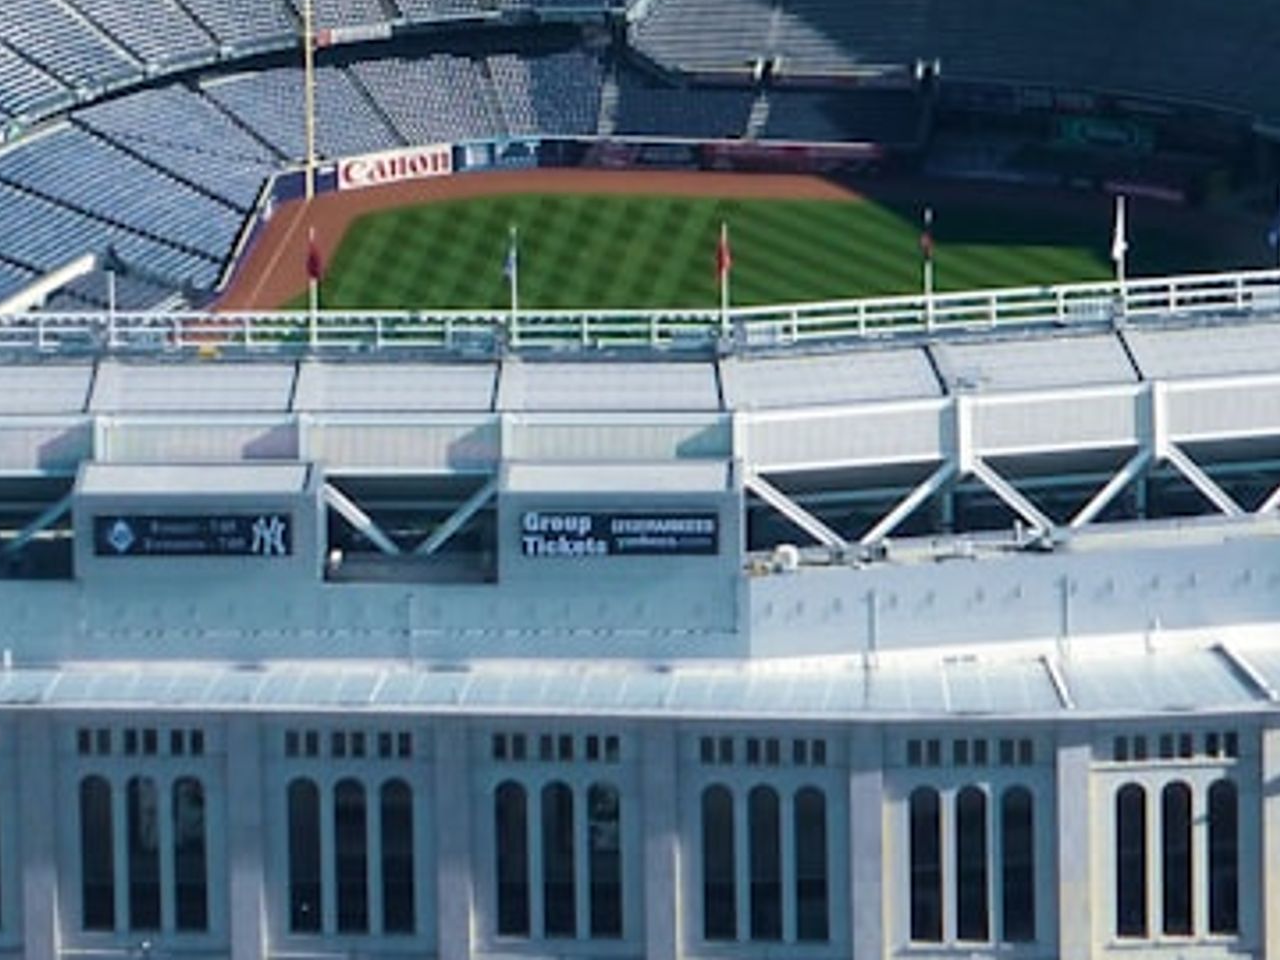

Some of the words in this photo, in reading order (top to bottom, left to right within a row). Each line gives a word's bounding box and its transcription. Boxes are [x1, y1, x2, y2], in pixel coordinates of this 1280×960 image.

[343, 151, 450, 183] Canon
[523, 512, 592, 537] Group
[523, 536, 607, 555] Tickets
